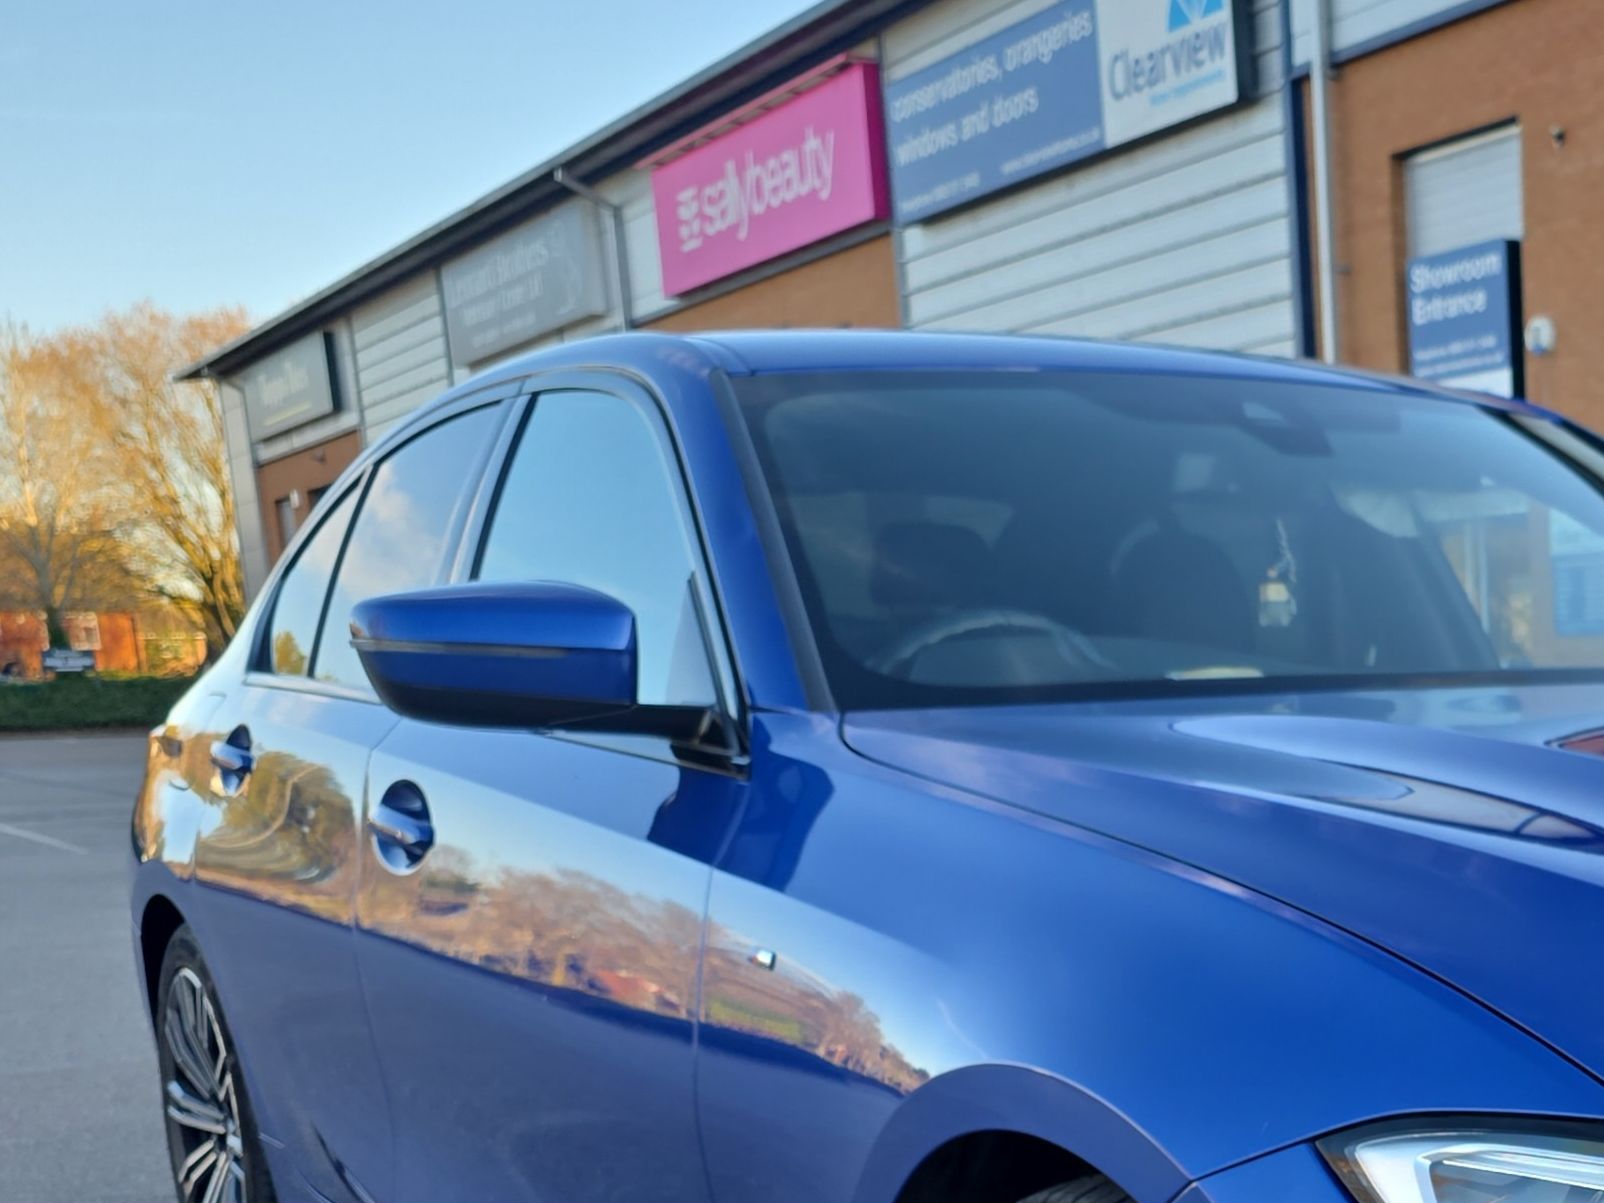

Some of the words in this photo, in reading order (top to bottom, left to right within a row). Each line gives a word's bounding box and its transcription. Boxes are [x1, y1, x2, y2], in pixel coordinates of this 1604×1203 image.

[1108, 21, 1227, 100] Clearview
[960, 100, 990, 141] and
[991, 86, 1040, 128] doors
[1410, 252, 1501, 294] Showroom
[1411, 287, 1488, 326] Entrance
